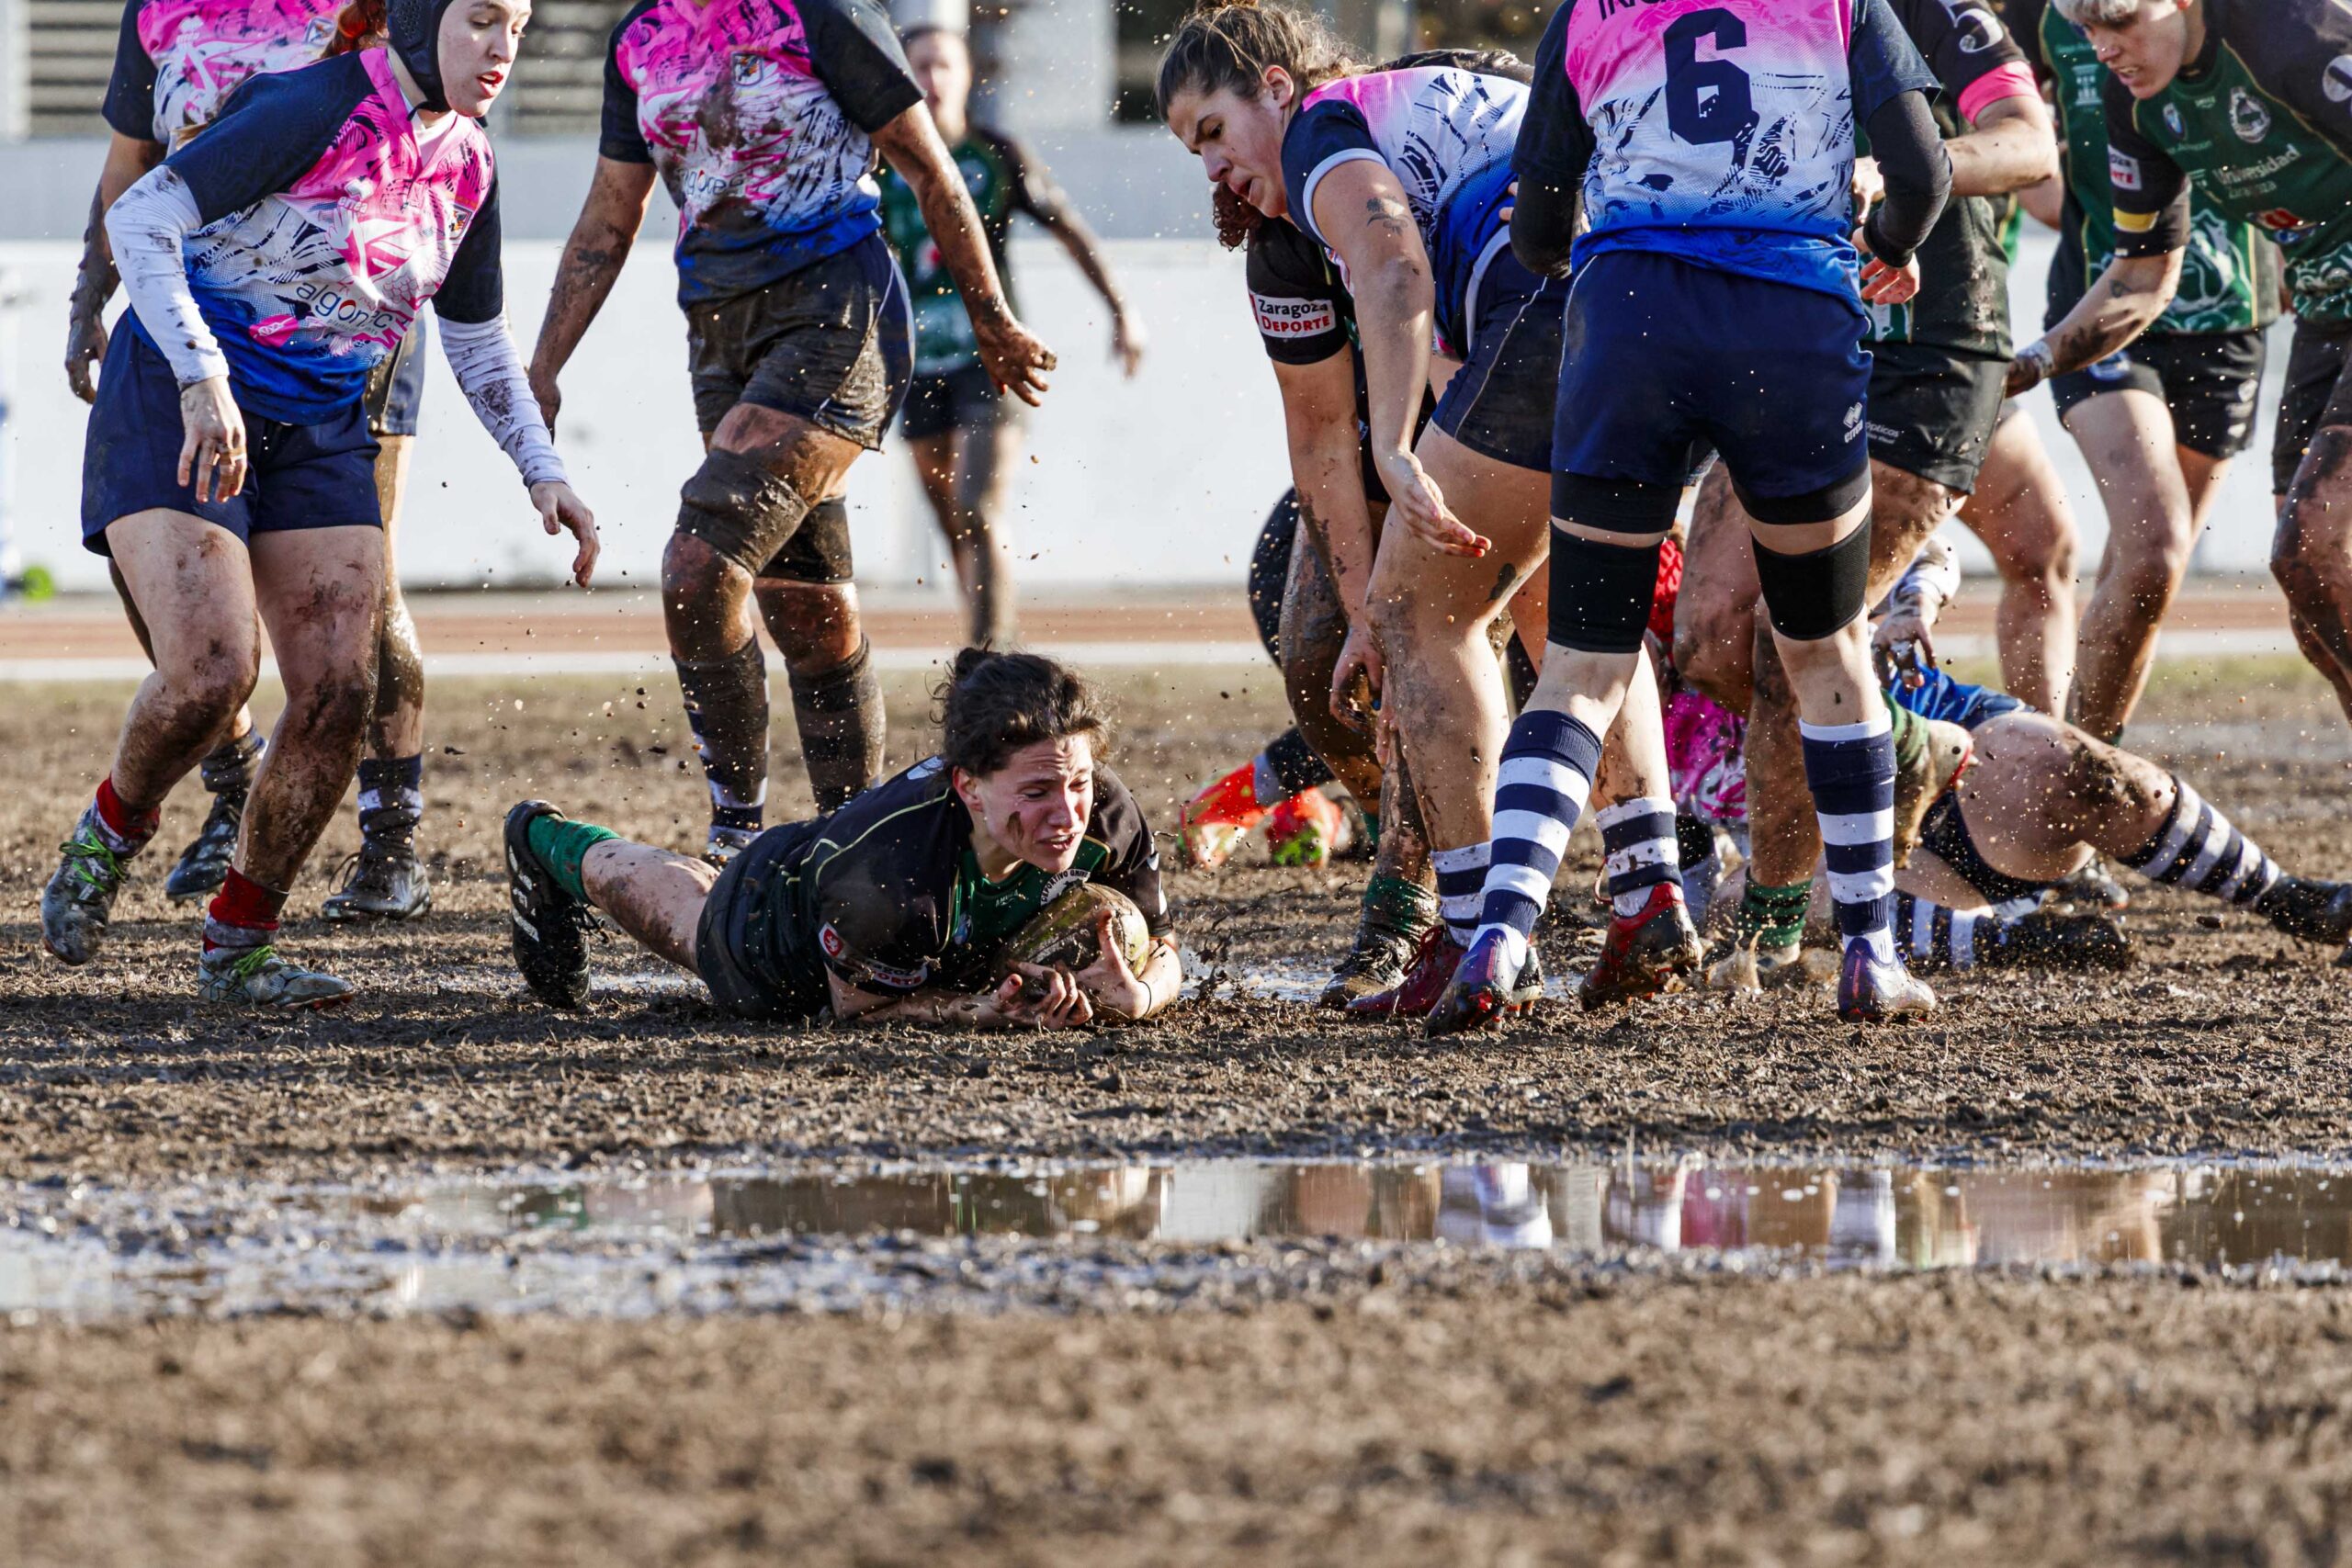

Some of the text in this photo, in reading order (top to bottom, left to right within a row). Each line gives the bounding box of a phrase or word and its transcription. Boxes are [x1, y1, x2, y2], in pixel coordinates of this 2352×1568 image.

[1663, 7, 1753, 145] 6
[1258, 299, 1329, 319] Zaragoza
[1261, 315, 1330, 332] DEPORTE
[1041, 871, 1069, 903] DEPORTIVO
